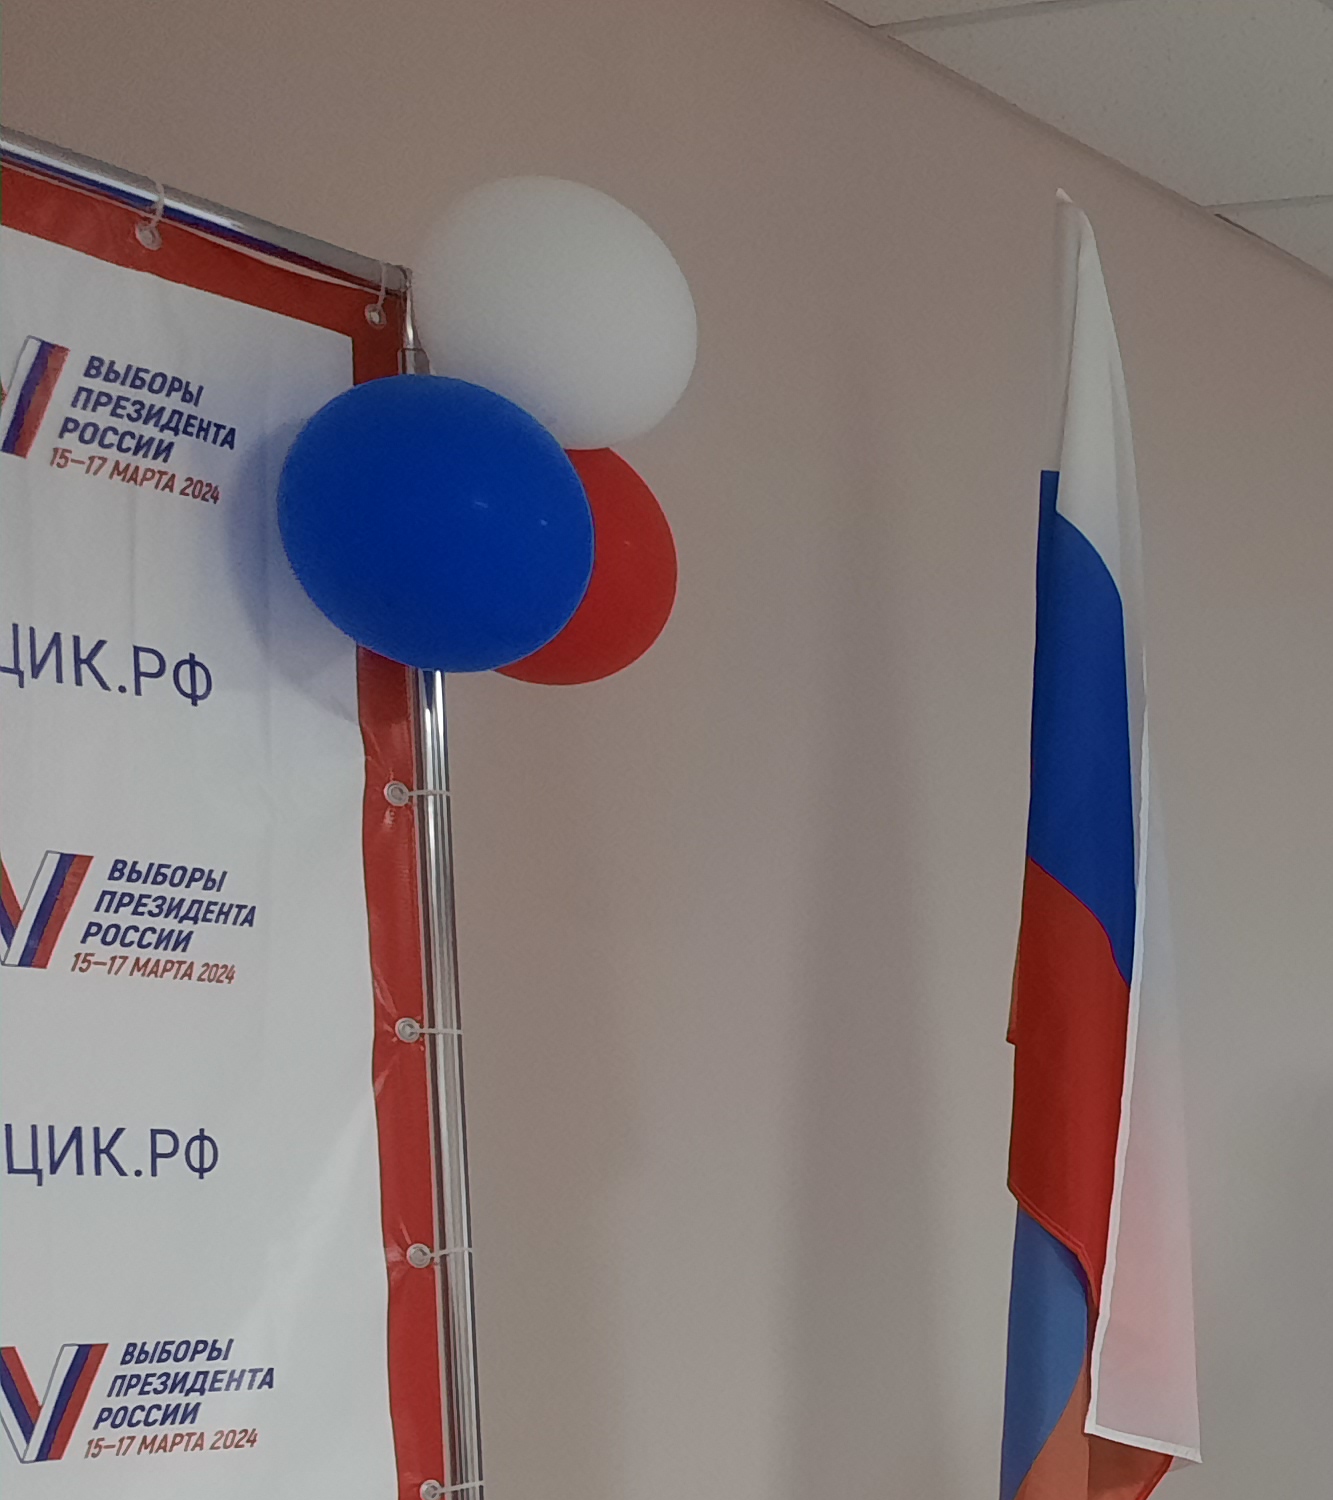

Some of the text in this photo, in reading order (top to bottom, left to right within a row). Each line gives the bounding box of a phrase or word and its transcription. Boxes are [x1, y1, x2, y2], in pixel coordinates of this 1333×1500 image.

[83, 355, 204, 407] ВЫБОРЫ
[71, 386, 237, 450] ПРЕЗИДЕНТА
[58, 417, 175, 463] РОССИИ
[109, 460, 176, 493] МАРТА
[179, 477, 220, 504] 2024
[107, 858, 228, 893] ВЫБОРЫ
[93, 890, 257, 928] ПРЕЗИДЕНТА
[80, 921, 194, 952] РОССИИ
[128, 957, 195, 981] МАРТА
[197, 962, 236, 985] 2024
[4, 1123, 219, 1187] ЦИК.РФ
[119, 1338, 234, 1366] ВЫБОРЫ
[106, 1367, 275, 1398] ПРЕЗИДЕНТА
[92, 1402, 202, 1431] РОССИИ
[136, 1431, 206, 1456] МАРТА
[208, 1428, 258, 1451] 2024
